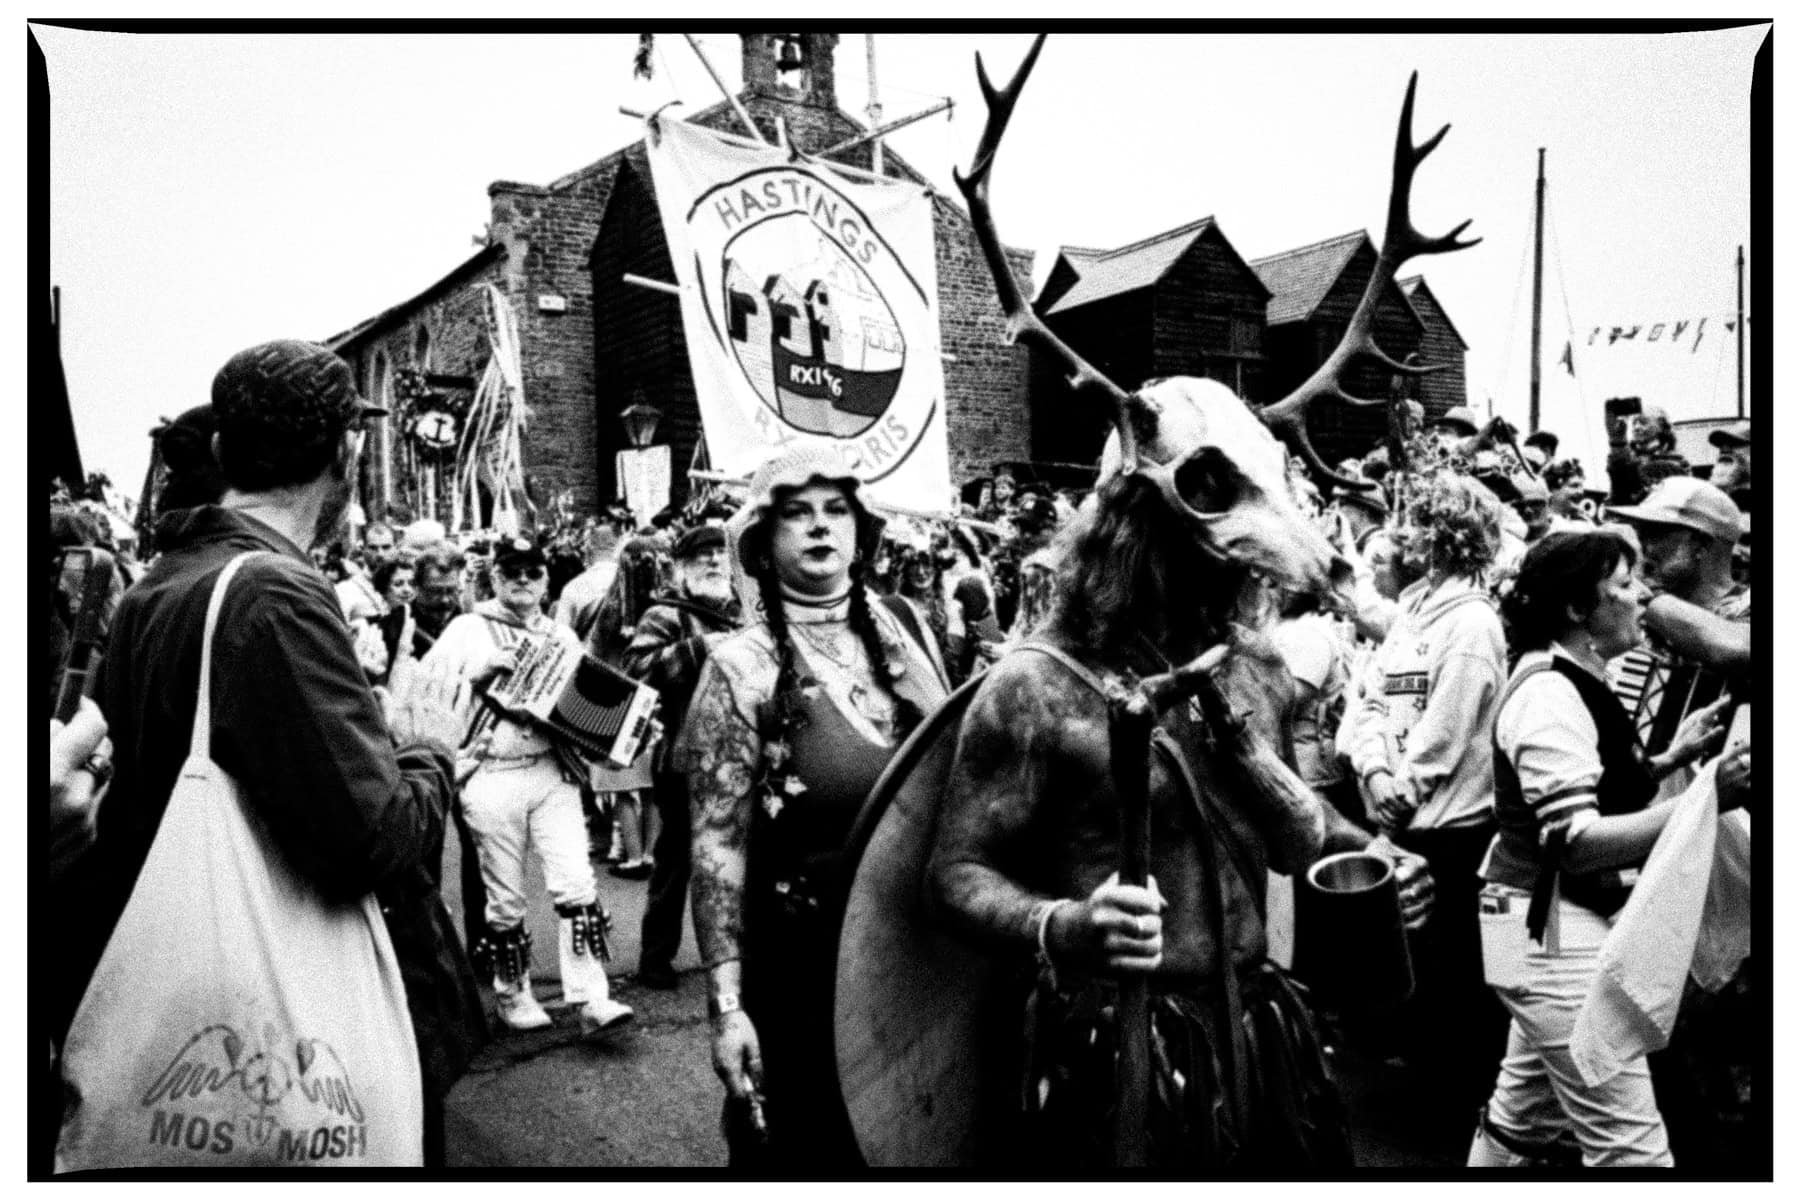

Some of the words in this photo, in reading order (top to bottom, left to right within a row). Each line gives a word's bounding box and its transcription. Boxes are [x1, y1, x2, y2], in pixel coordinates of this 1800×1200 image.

[715, 179, 878, 264] HASTINGS
[149, 1110, 235, 1154] MOS
[277, 1125, 367, 1161] MOSH
